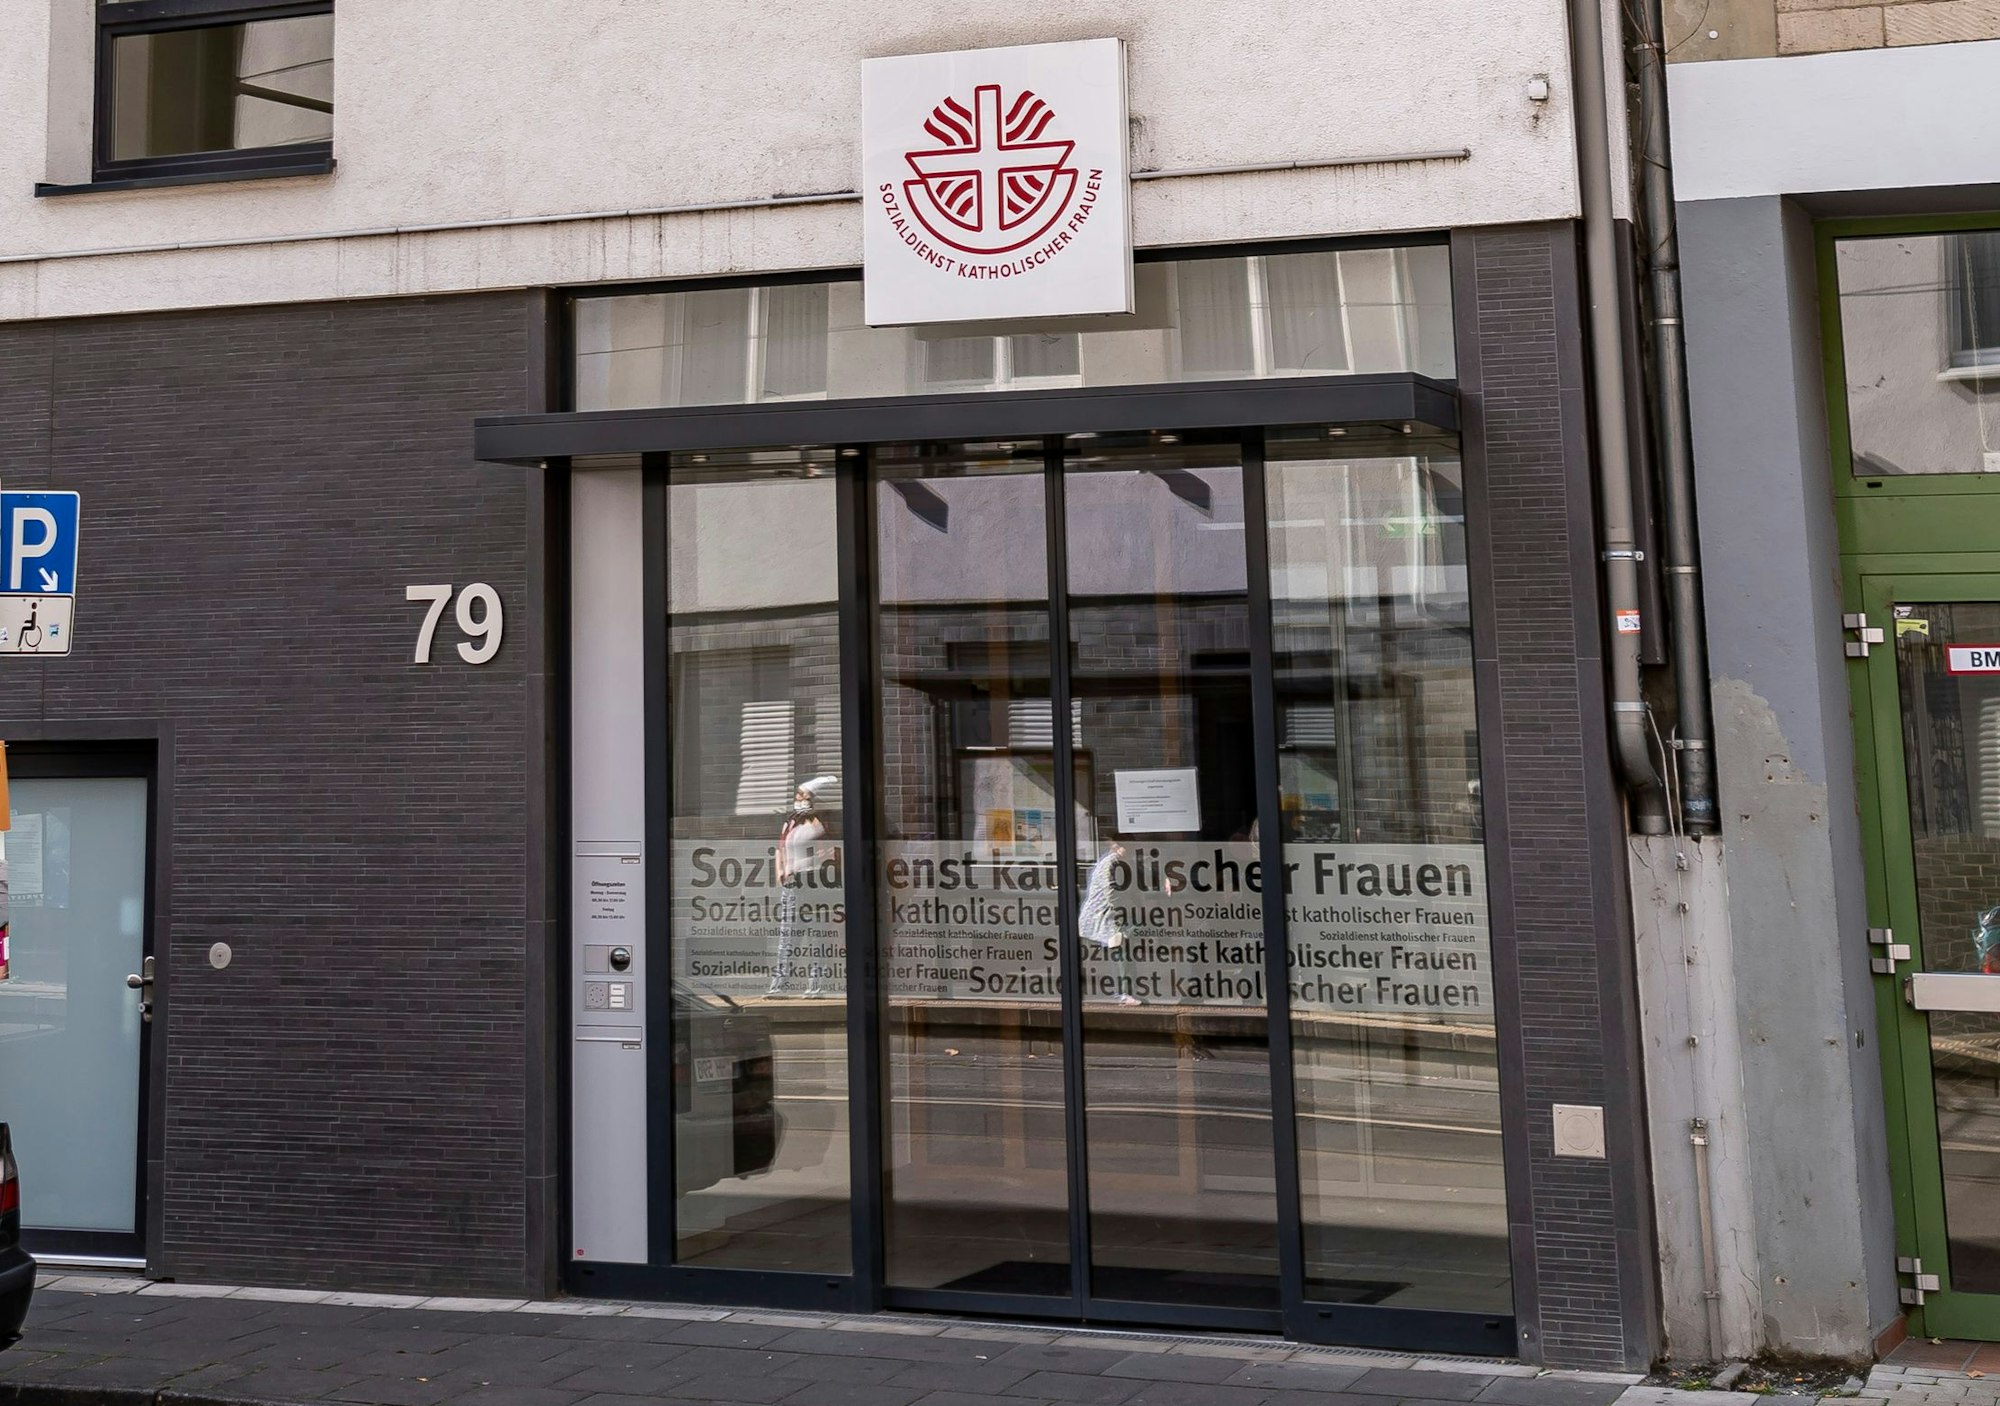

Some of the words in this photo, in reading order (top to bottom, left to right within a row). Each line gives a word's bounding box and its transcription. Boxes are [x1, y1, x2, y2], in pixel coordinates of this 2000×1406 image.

[879, 182, 956, 273] SOZIALDIENST
[957, 230, 1073, 280] KATHOLISCHER
[1070, 168, 1104, 233] FRAUEN
[10, 507, 58, 590] P
[406, 582, 503, 665] 79
[1313, 852, 1473, 897] Frauen
[1303, 905, 1411, 925] katholischer
[1415, 907, 1475, 926] Frauen
[691, 926, 747, 938] Sozialdienst
[807, 927, 839, 938] Frauen
[948, 929, 1002, 941] katholischer
[1004, 930, 1034, 941] Frauen
[1133, 928, 1185, 938] Sozialdienst
[1186, 929, 1239, 939] katholischer
[1319, 930, 1379, 942] Sozialdienst
[1380, 931, 1441, 943] katholischer
[1442, 934, 1476, 943] Frauen
[897, 944, 983, 959] katholischer
[986, 946, 1033, 961] Frauen
[1391, 946, 1477, 970] Frauen
[916, 963, 968, 981] Frauen
[1170, 968, 1368, 1004] katholscher
[1376, 976, 1480, 1007] Frauen
